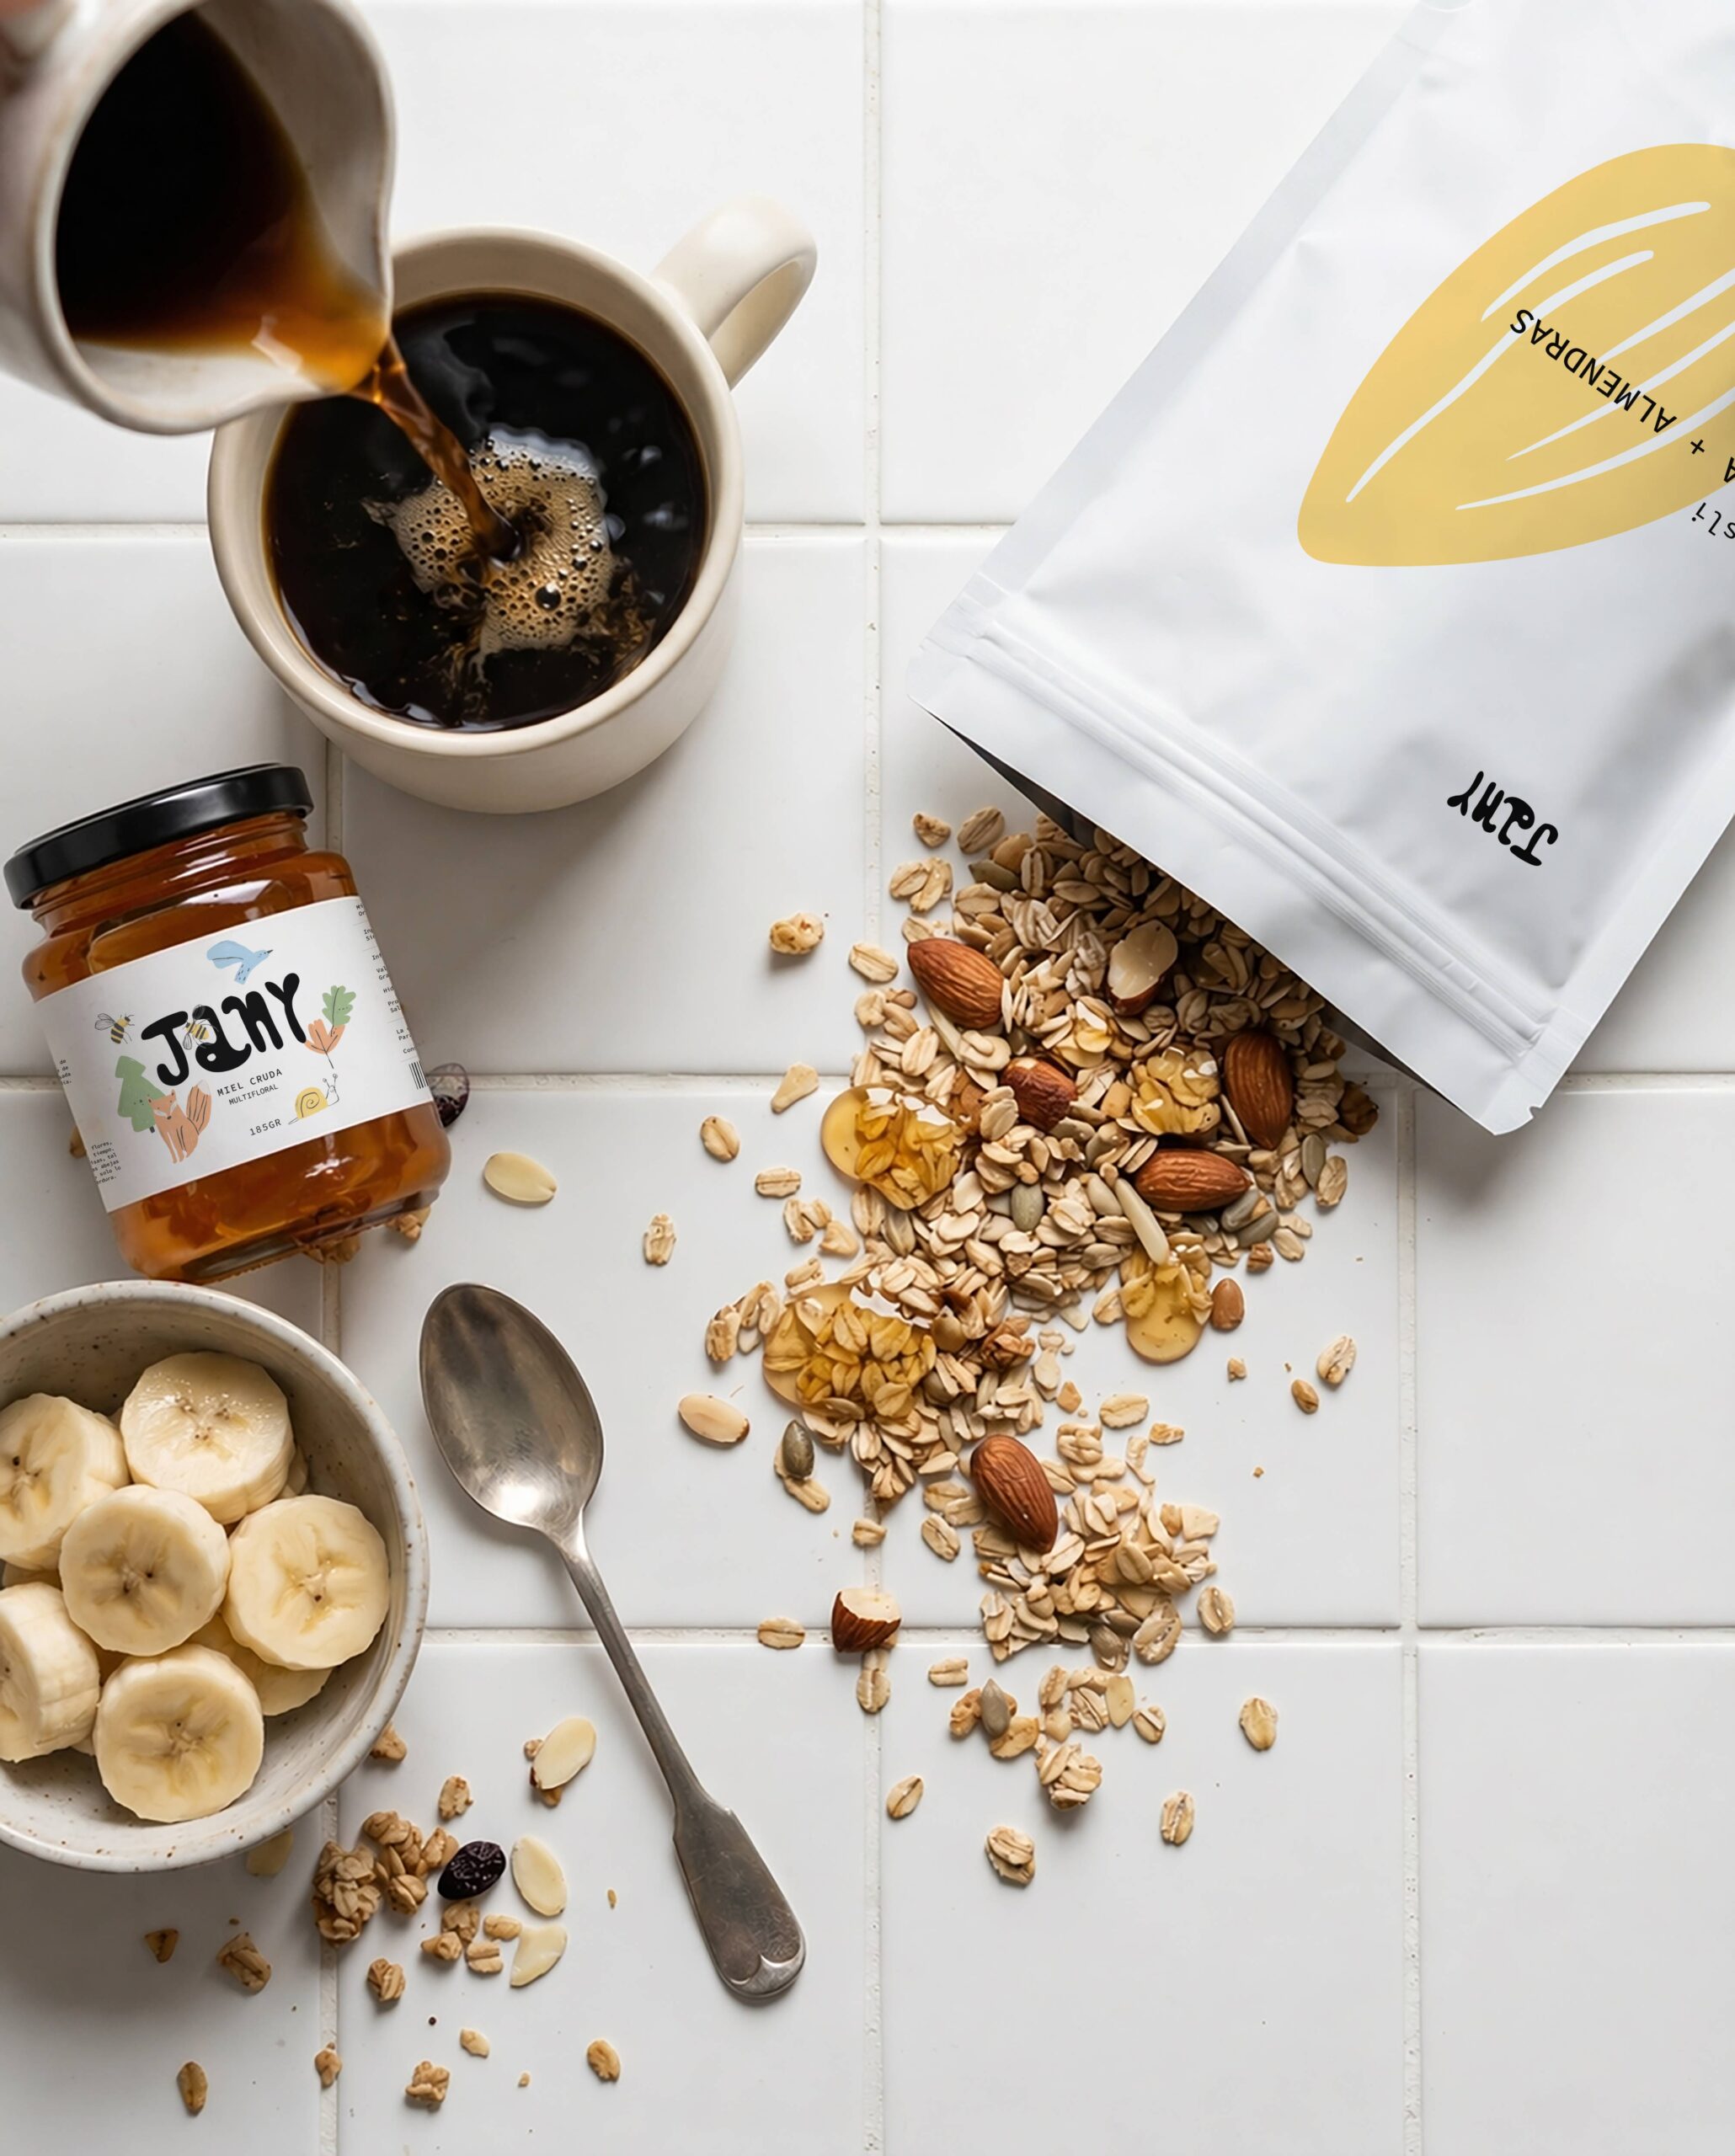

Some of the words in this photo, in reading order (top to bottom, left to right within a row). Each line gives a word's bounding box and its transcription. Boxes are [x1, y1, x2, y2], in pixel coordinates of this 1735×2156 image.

[1510, 309, 1677, 433] ALMENDRAS
[1690, 440, 1705, 454] +
[217, 1081, 244, 1097] MIEL
[249, 1069, 283, 1085] CRUDA
[228, 1084, 279, 1105] MULTIFLORAL
[249, 1118, 282, 1136] 185GR
